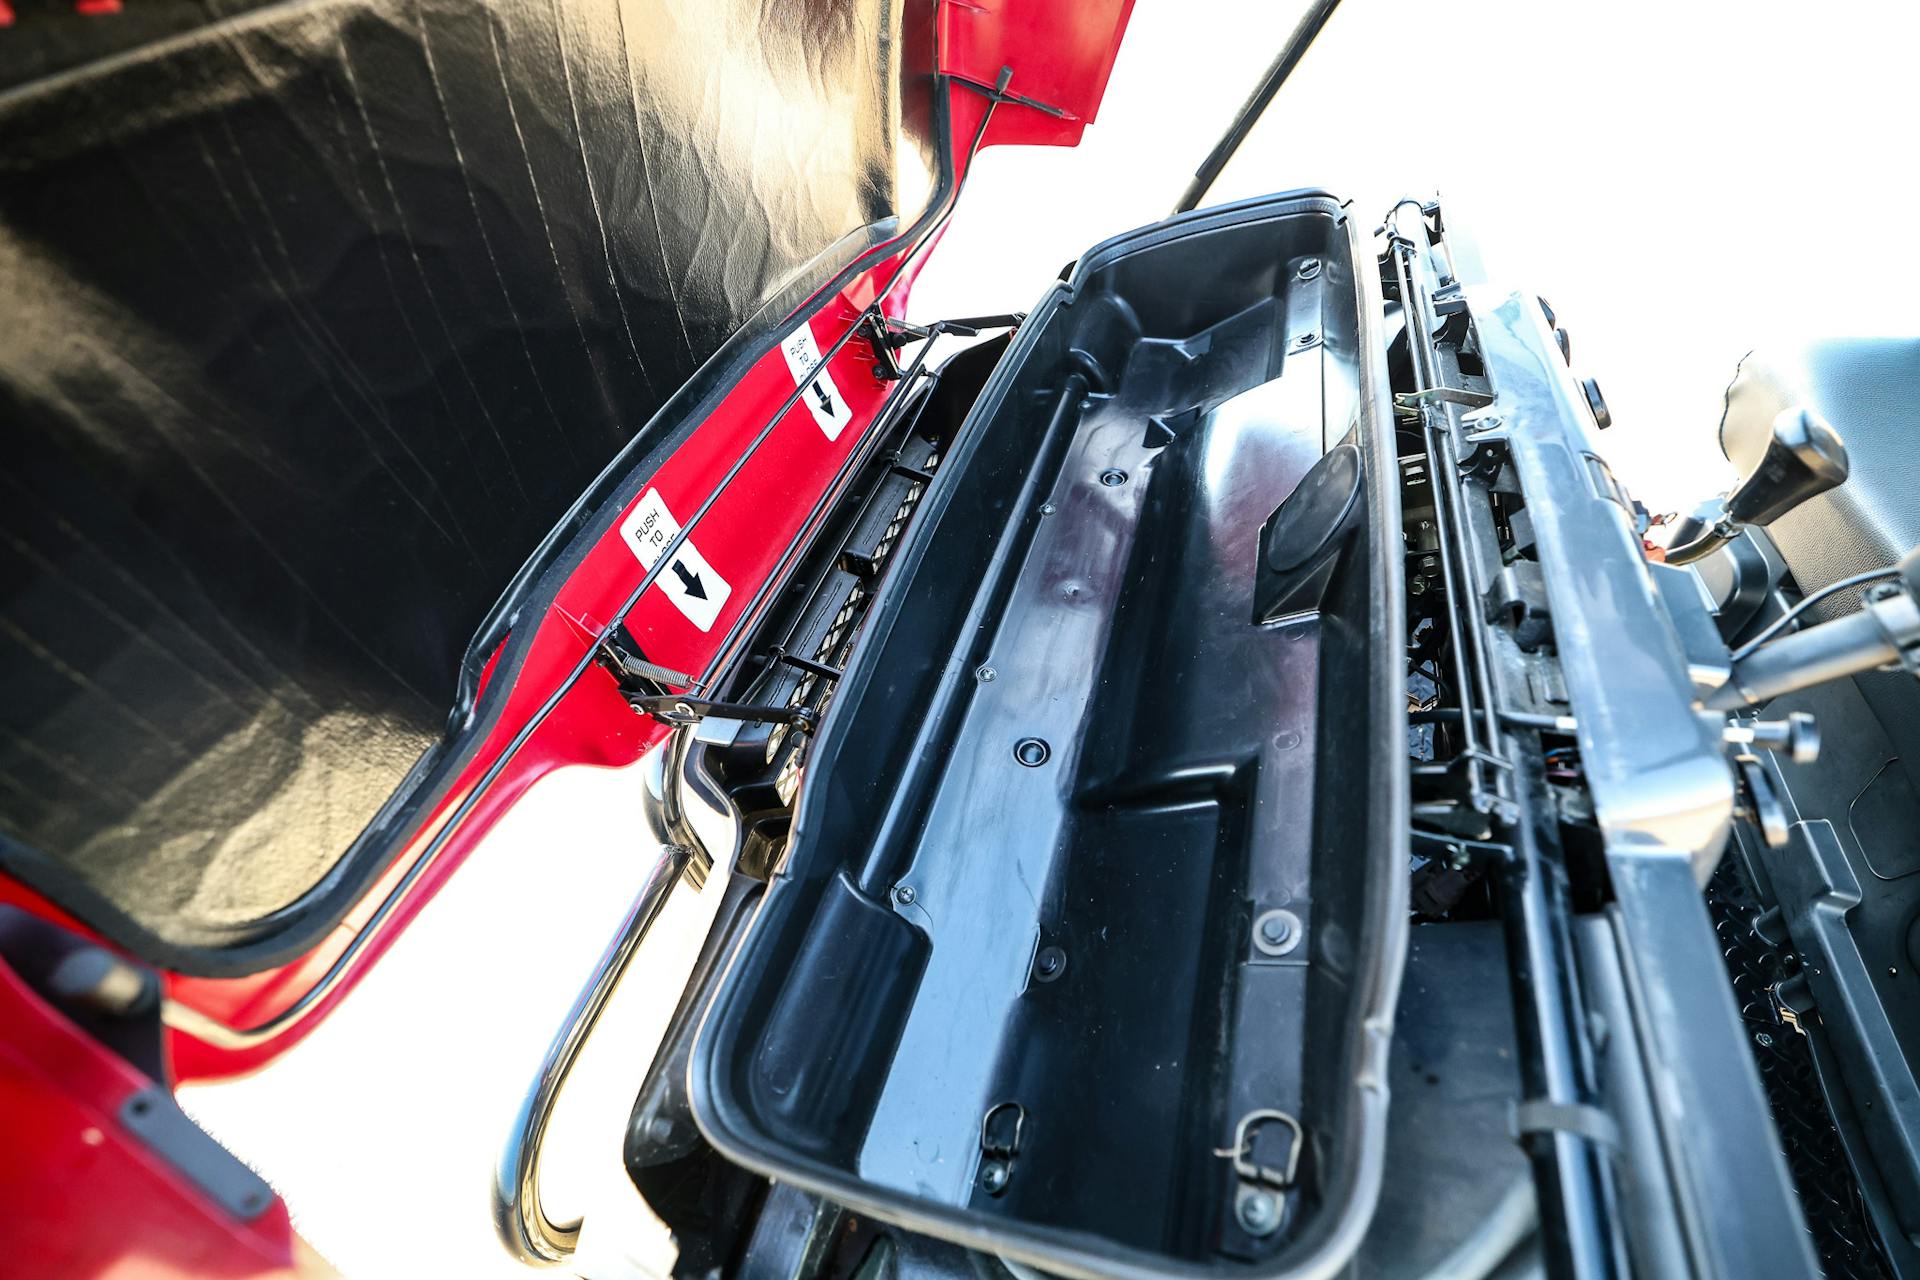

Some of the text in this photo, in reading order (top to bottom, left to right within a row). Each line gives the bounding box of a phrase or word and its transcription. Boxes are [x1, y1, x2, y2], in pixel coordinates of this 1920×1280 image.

[790, 335, 808, 358] PUSH
[799, 352, 809, 366] TO
[635, 508, 660, 543] PUSH
[649, 529, 664, 547] TO
